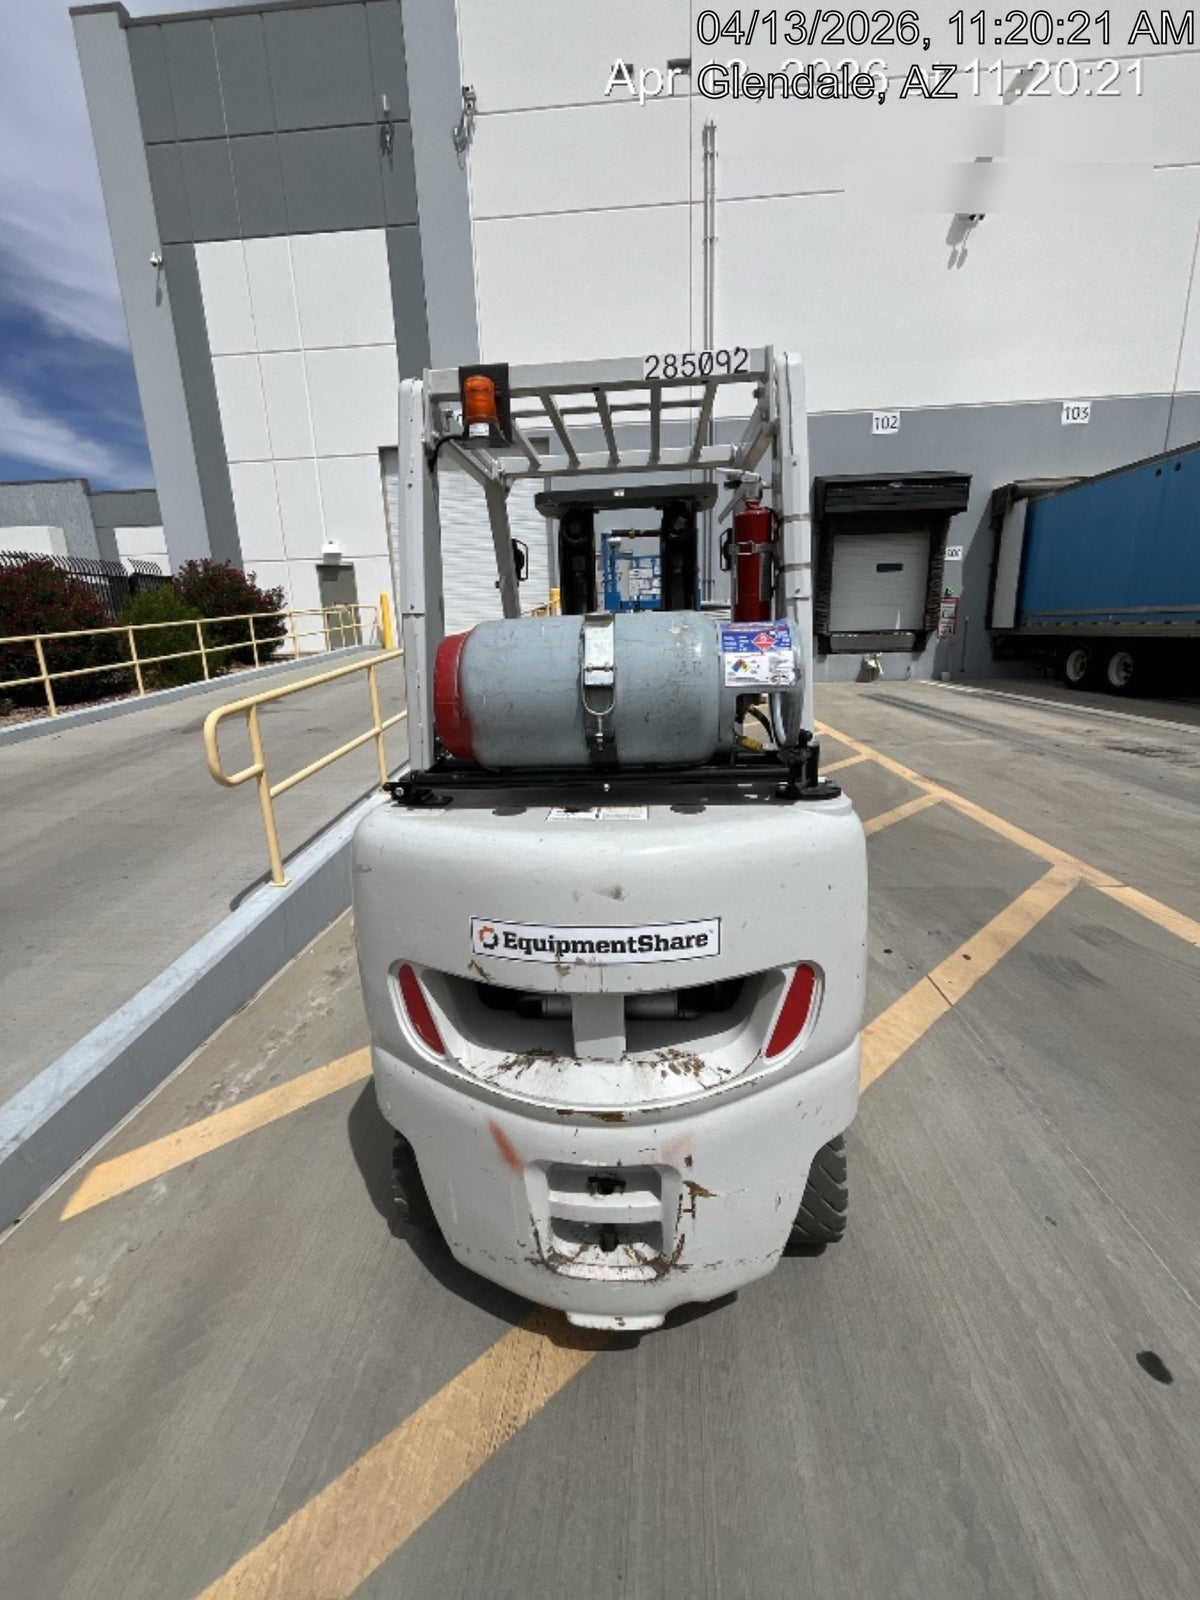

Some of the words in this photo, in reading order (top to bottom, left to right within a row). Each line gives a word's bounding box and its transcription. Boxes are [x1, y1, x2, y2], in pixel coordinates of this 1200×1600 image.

[645, 346, 749, 381] 285092
[875, 415, 898, 431] 102
[1064, 406, 1089, 421] 103
[502, 930, 709, 956] EquipmentShare
